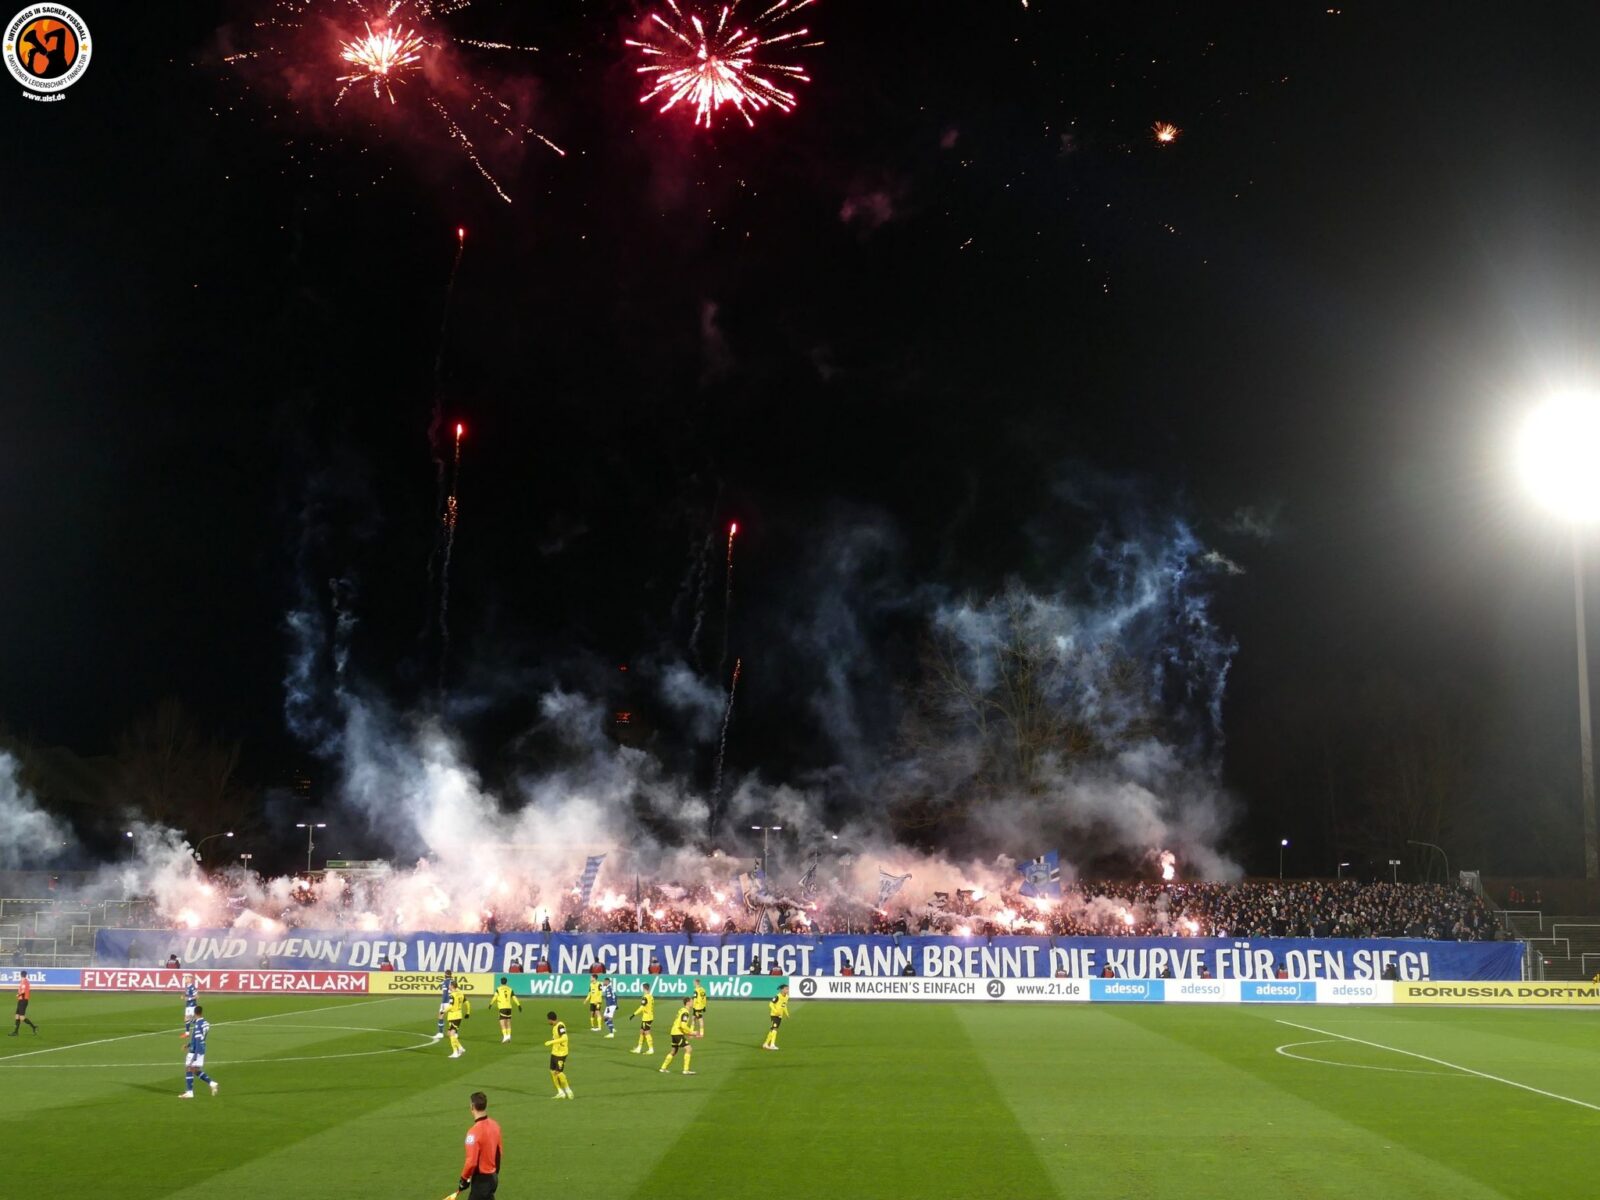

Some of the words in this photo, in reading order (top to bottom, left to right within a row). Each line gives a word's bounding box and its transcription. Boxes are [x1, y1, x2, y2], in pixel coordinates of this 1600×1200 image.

[185, 937, 247, 963] UND
[256, 938, 342, 964] WENN
[348, 940, 407, 971] DER
[416, 940, 494, 973] WIND
[502, 941, 550, 973] BEI
[558, 943, 656, 974] NACHT
[664, 943, 823, 976] VERFLIEGT,
[833, 944, 912, 976] DANN
[923, 945, 1039, 978] BRENNT
[1049, 947, 1097, 979] DIE
[1106, 947, 1205, 979] KURVE
[1215, 941, 1276, 979] FÜR
[1285, 949, 1345, 980] DEN
[1353, 949, 1430, 981] SIEG!
[0, 971, 46, 982] a-Bnk
[84, 971, 211, 989] FLYERALARM
[238, 973, 367, 991] FLYERALARM
[394, 975, 468, 983] BORUSIA
[388, 983, 474, 991] DORTMND
[530, 975, 573, 995] wilo
[602, 976, 687, 995] lo.d/bvb
[708, 977, 753, 997] wilo
[802, 981, 815, 994] 21
[829, 982, 851, 993] WIR
[924, 982, 975, 994] EINFACH
[989, 981, 1003, 995] 21
[1017, 983, 1080, 995] www.21.de
[1105, 983, 1145, 994] adesso
[1181, 984, 1221, 995] adesso
[1256, 984, 1297, 996] adesso
[1333, 985, 1373, 996] adesso
[1408, 987, 1513, 997] BORUSSIA
